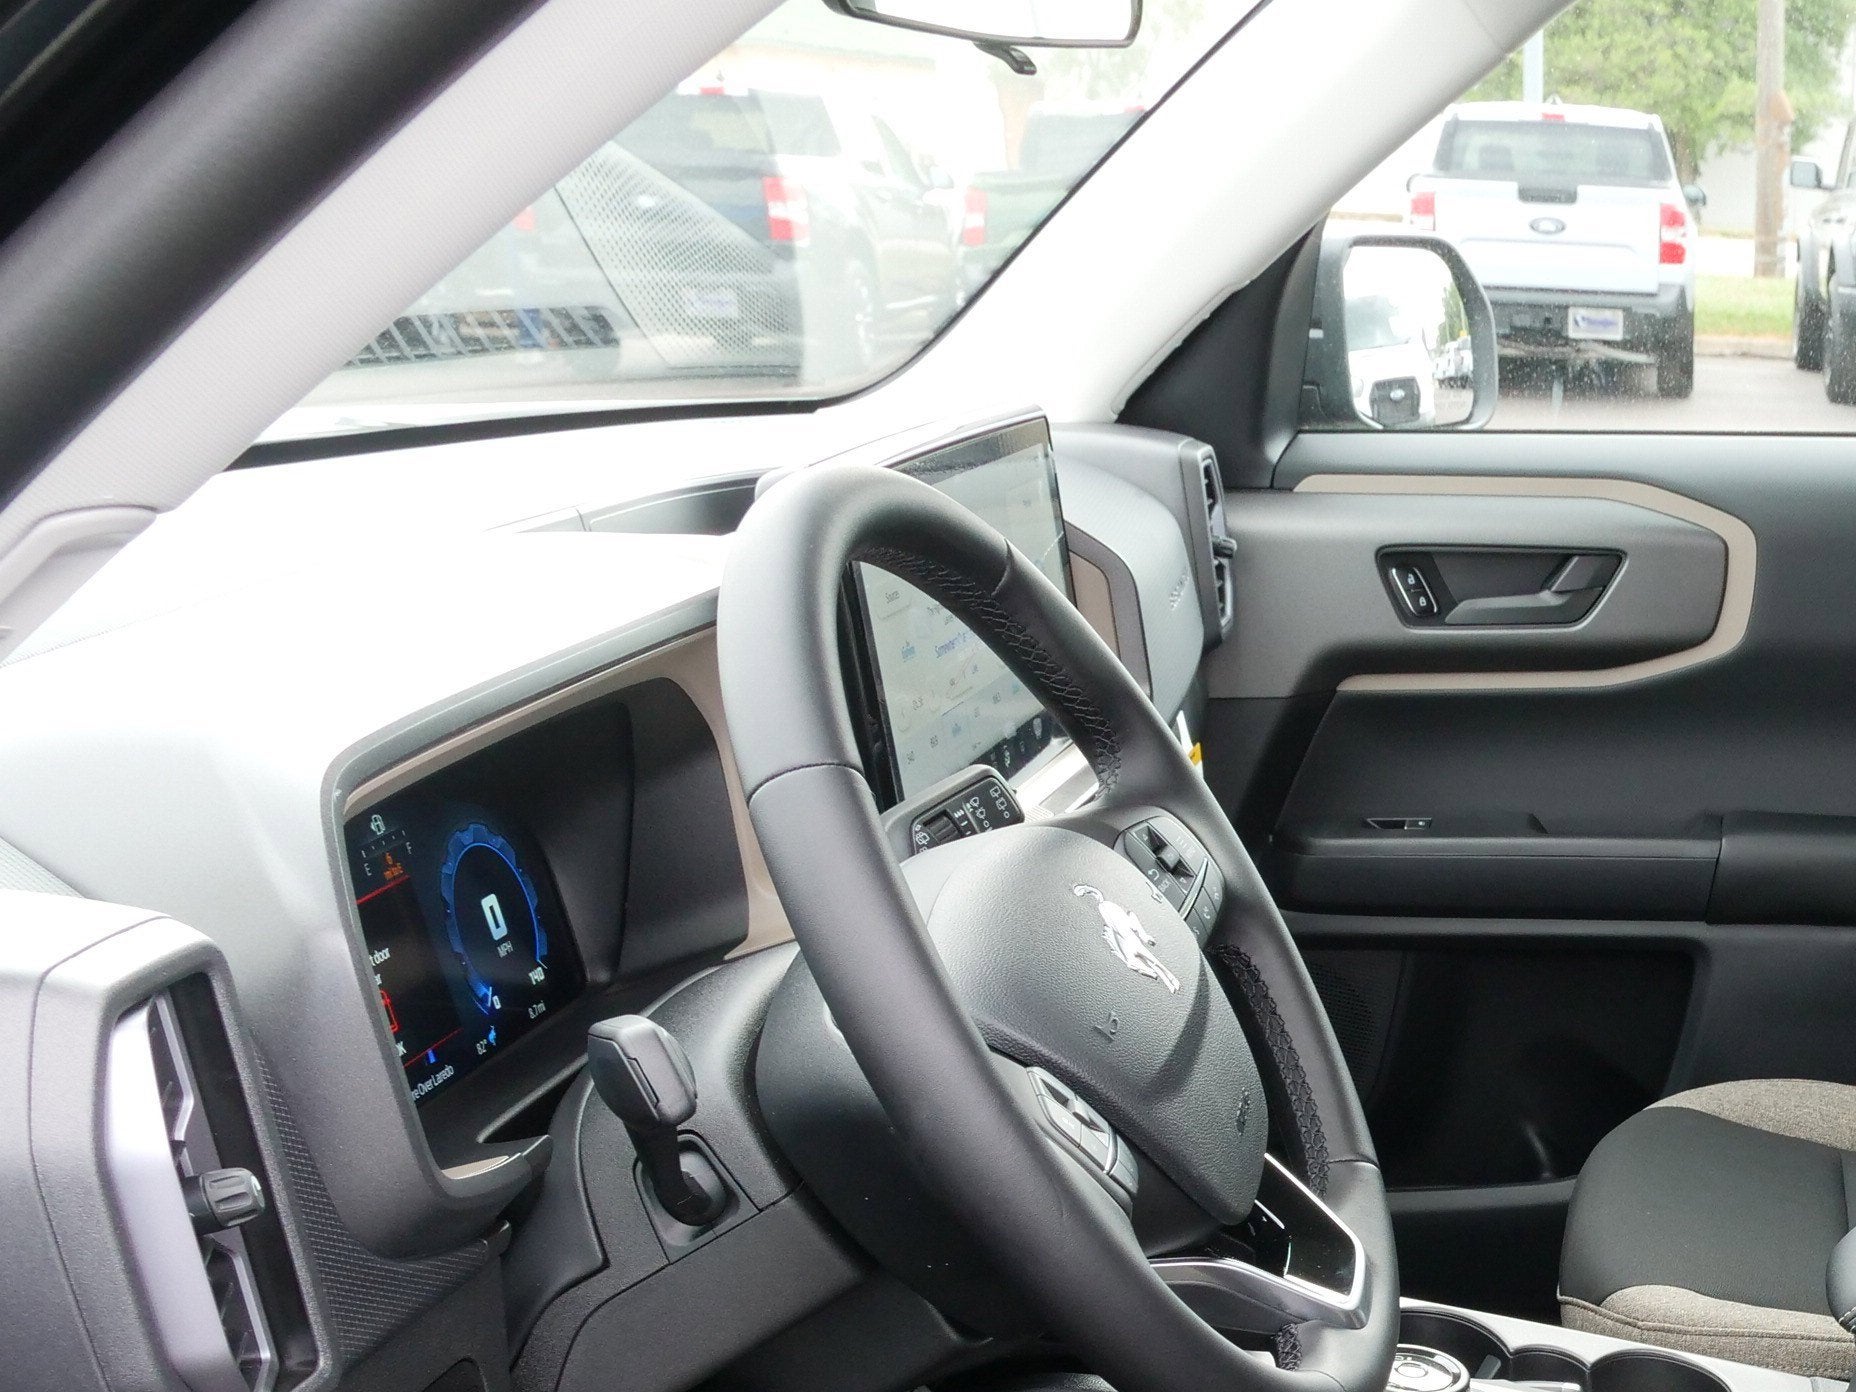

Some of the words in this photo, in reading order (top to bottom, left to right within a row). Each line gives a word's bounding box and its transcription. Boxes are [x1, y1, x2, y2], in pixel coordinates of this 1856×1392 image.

[363, 862, 372, 876] E
[481, 893, 508, 941] 0
[373, 947, 391, 965] door
[496, 940, 514, 959] MPH
[528, 966, 545, 985] 140
[417, 1078, 434, 1095] Over
[431, 1064, 454, 1086] Laredo
